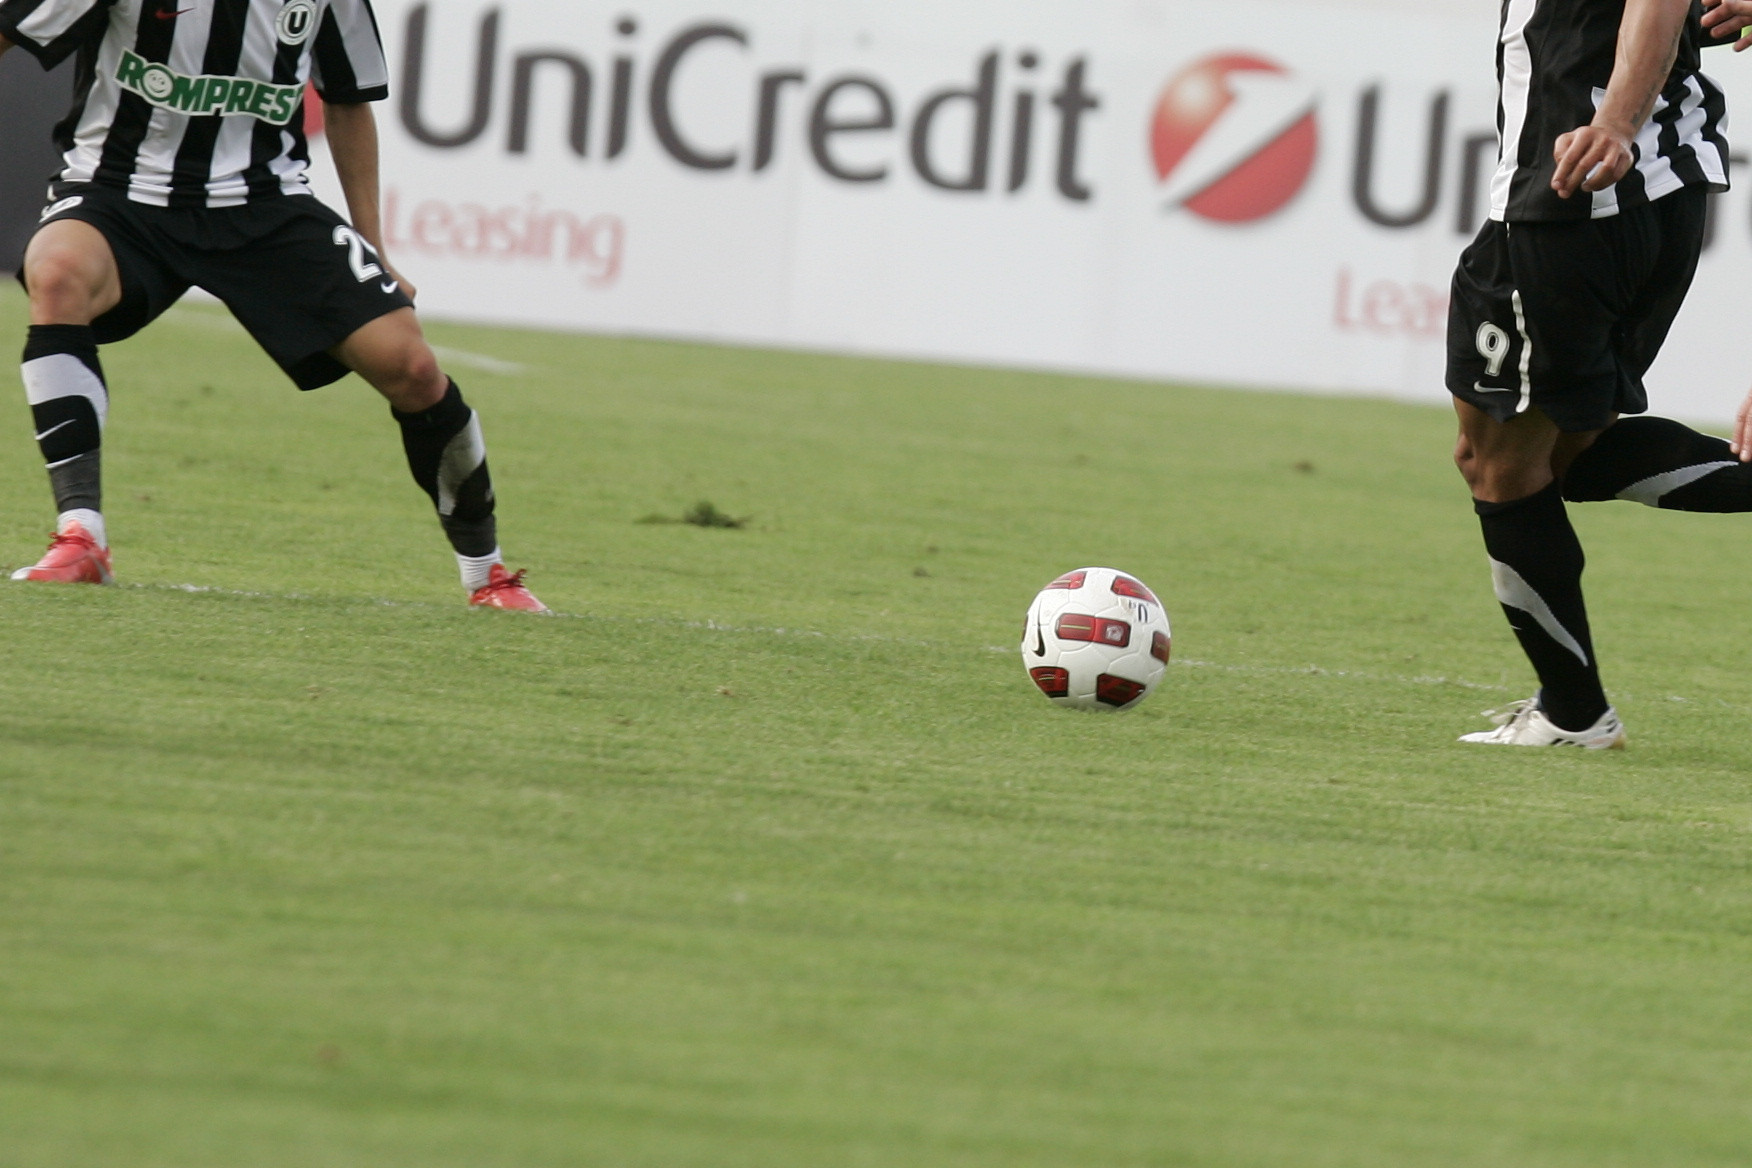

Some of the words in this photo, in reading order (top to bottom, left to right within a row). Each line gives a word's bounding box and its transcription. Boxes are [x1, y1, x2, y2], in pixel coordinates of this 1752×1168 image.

[116, 50, 304, 123] ROMPRES
[381, 190, 625, 286] Leasing
[1475, 320, 1511, 377] 9
